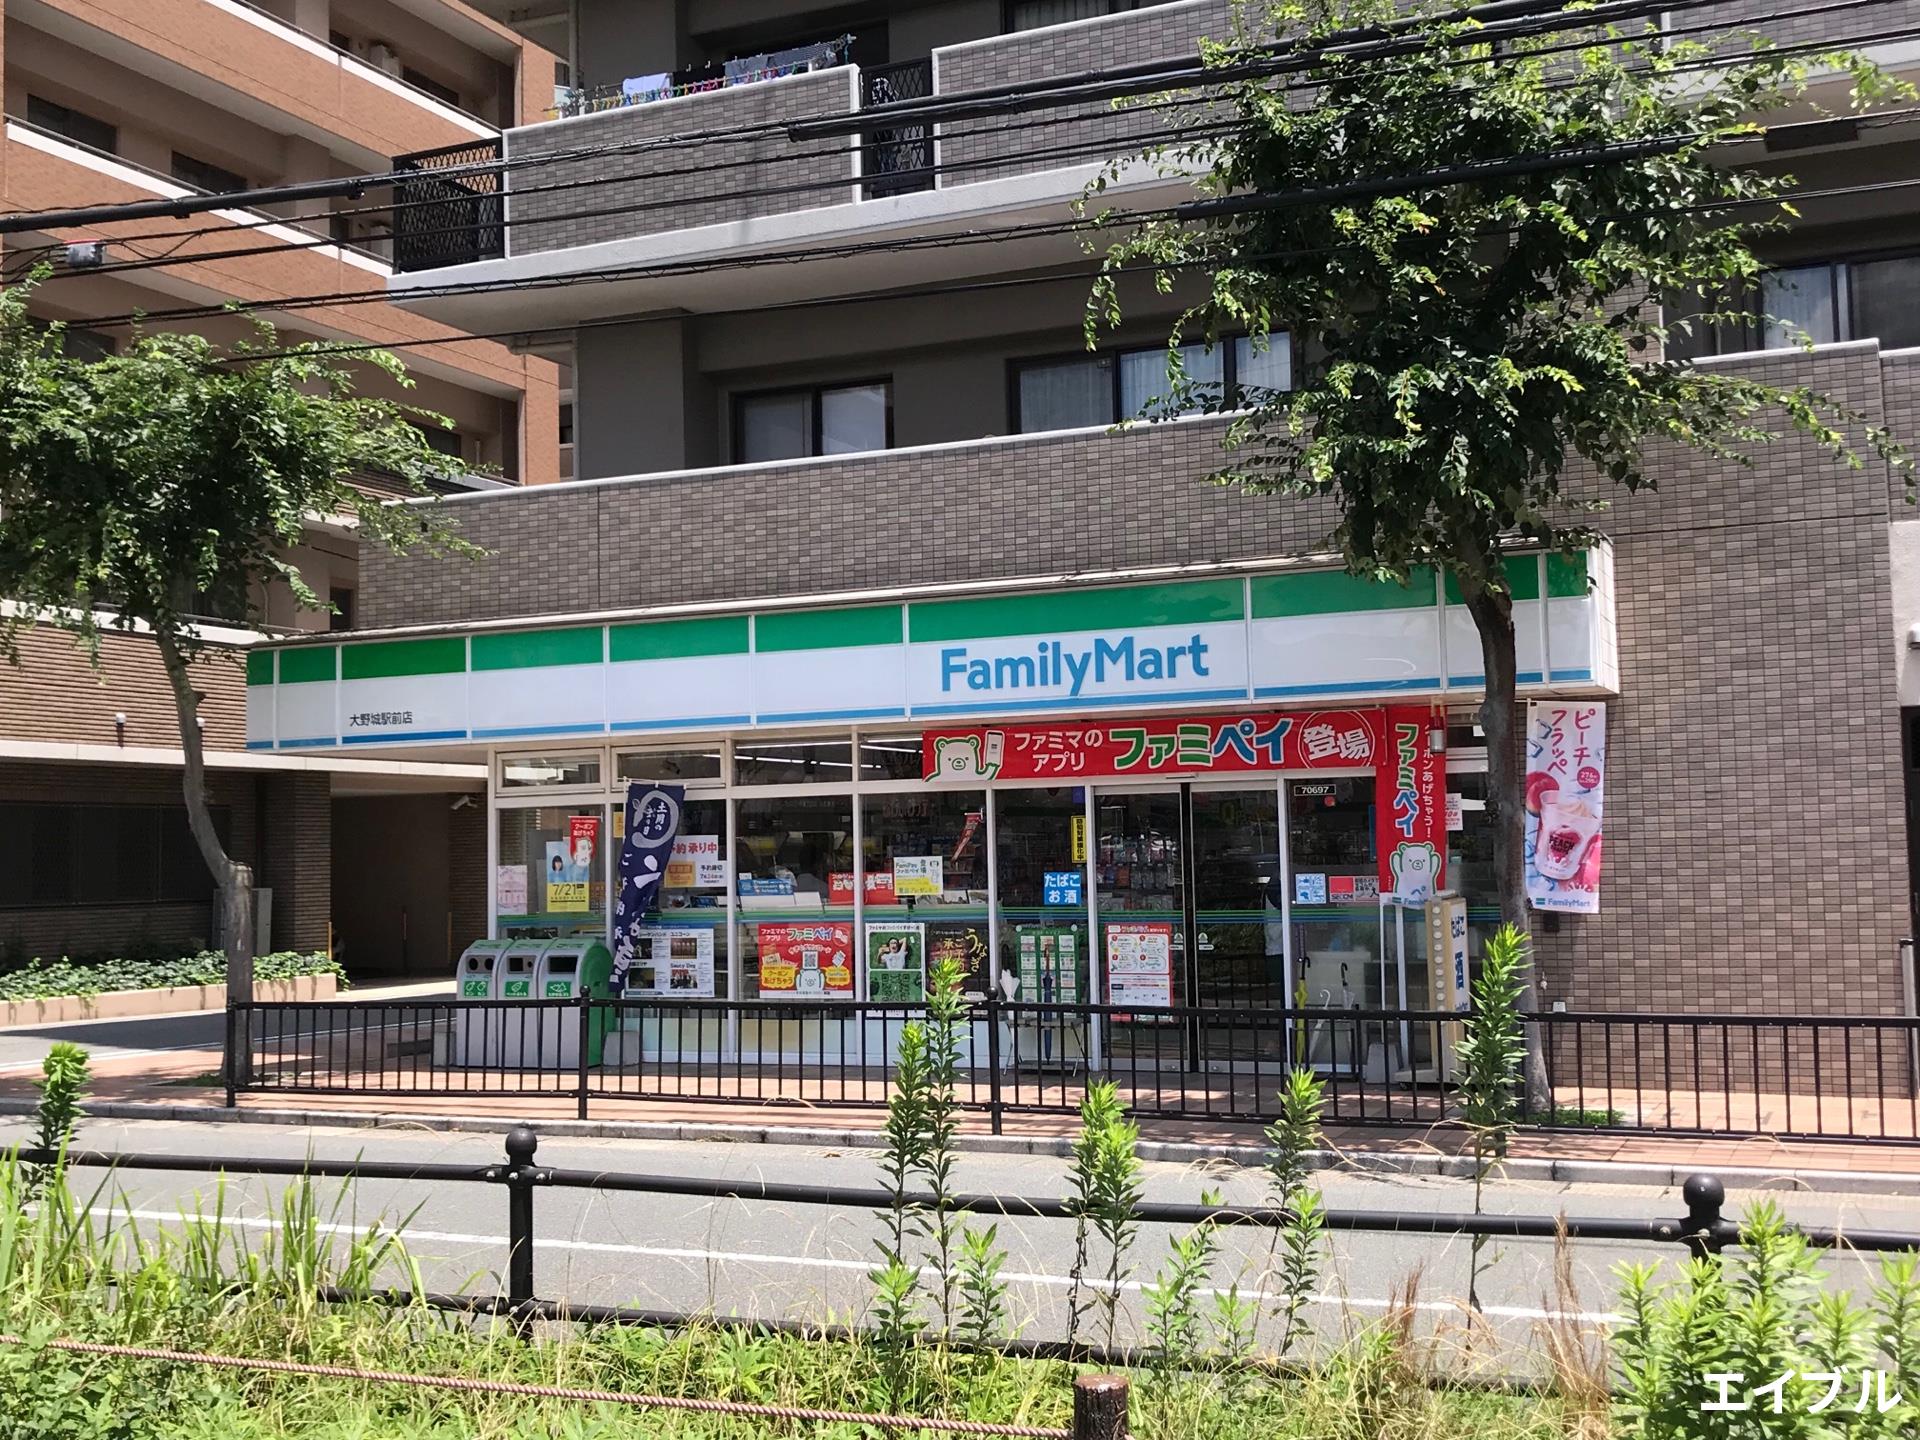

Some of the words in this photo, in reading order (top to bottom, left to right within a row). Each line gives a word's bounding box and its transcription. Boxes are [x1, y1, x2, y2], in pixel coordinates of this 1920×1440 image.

[941, 634, 1209, 697] FamilyMart
[349, 710, 413, 727] 大野城駅前店
[1014, 729, 1103, 751] ファミマの
[1109, 718, 1293, 769] ファミペイ
[1303, 723, 1372, 761] 登場
[1547, 709, 1568, 775] フラッペ
[1574, 708, 1596, 767] ピーチ
[1032, 751, 1085, 772] アプリ
[1301, 786, 1330, 794] 70697
[1393, 723, 1419, 837] ファミペイ
[553, 884, 577, 896] 7/21
[1044, 873, 1080, 888] たばこ
[1048, 889, 1077, 904] お酒
[1547, 898, 1590, 908] FamilyMart
[788, 926, 834, 941] ファミペイ
